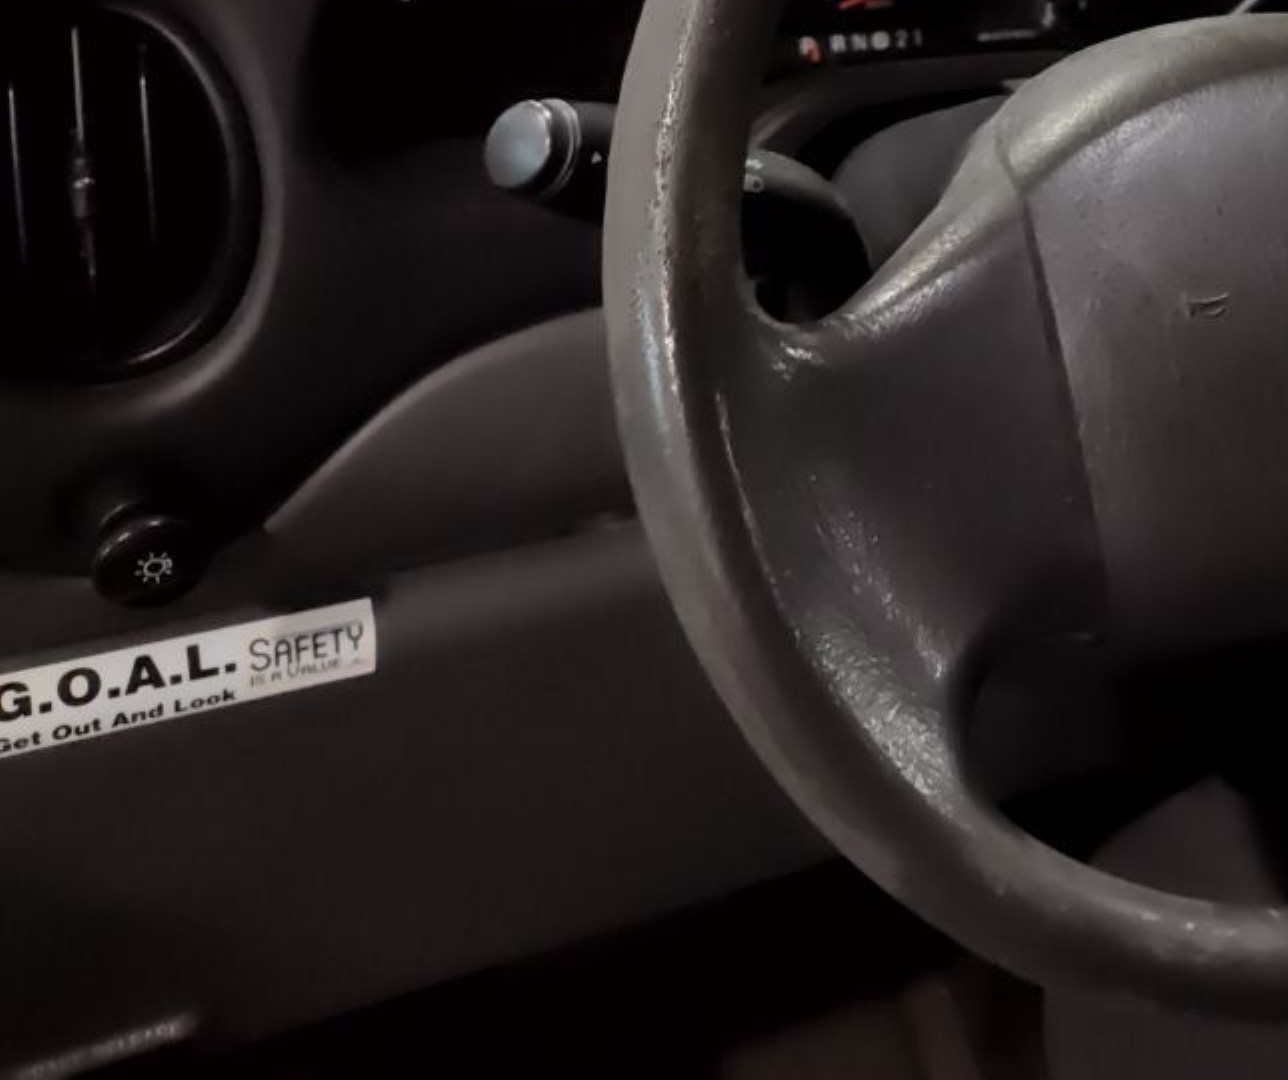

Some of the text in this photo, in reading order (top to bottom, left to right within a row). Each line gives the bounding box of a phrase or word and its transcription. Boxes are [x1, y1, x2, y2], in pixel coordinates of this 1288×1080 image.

[250, 621, 364, 672] SAFETY
[0, 645, 237, 722] G.O.A.L.
[52, 719, 101, 741] Out
[112, 703, 164, 728] And
[174, 688, 236, 713] Look
